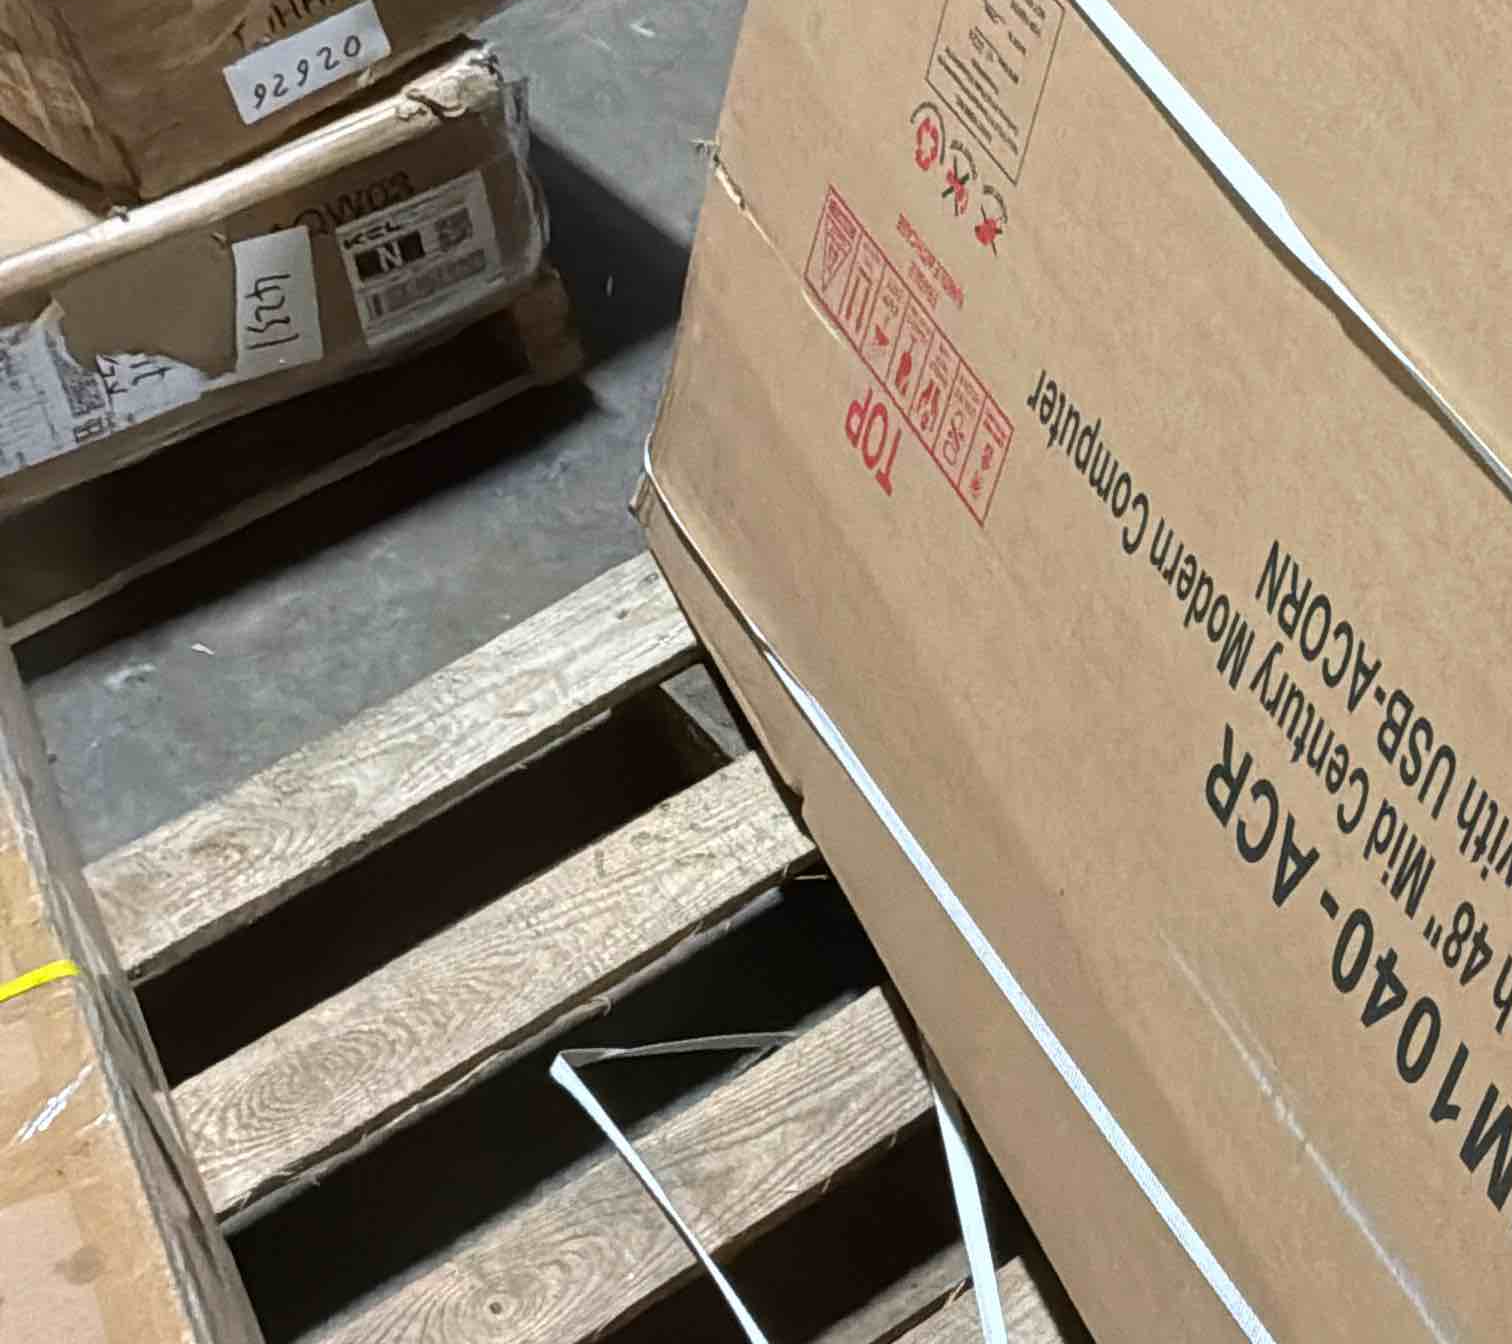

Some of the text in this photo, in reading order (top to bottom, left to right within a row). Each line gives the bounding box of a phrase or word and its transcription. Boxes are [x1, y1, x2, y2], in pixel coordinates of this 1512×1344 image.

[844, 388, 901, 496] TOP
[1028, 371, 1148, 552] Computer
[1130, 519, 1254, 683] Modern
[1256, 541, 1455, 819] USB-ACORN
[1250, 642, 1368, 833] Century
[1364, 799, 1435, 915] Mid
